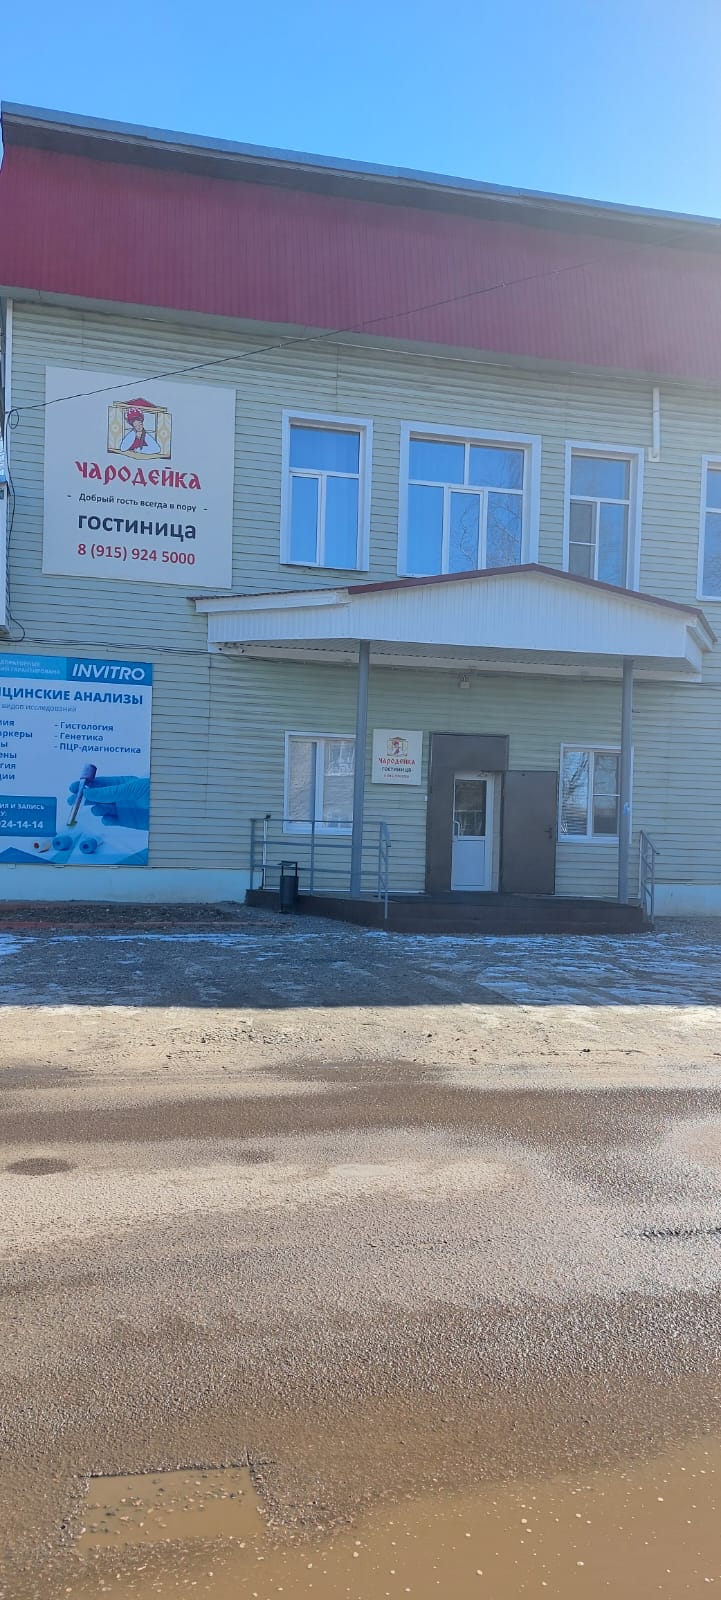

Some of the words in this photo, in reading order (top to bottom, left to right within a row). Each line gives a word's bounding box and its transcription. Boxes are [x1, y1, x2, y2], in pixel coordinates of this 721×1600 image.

[79, 493, 114, 505] Добрый
[116, 498, 138, 507] гость
[140, 499, 168, 509] всегда
[176, 503, 197, 513] пору
[78, 515, 196, 542] гостиница
[77, 543, 86, 555] 8
[91, 544, 127, 561] (915)
[131, 548, 157, 561] 924
[162, 551, 195, 565] 5000
[72, 663, 145, 681] INVITRO
[73, 691, 143, 705] АНАЛИЗЫ
[60, 721, 114, 732] Гистология
[60, 732, 104, 742] Генетика
[59, 743, 142, 754] ПЦР-диагностика
